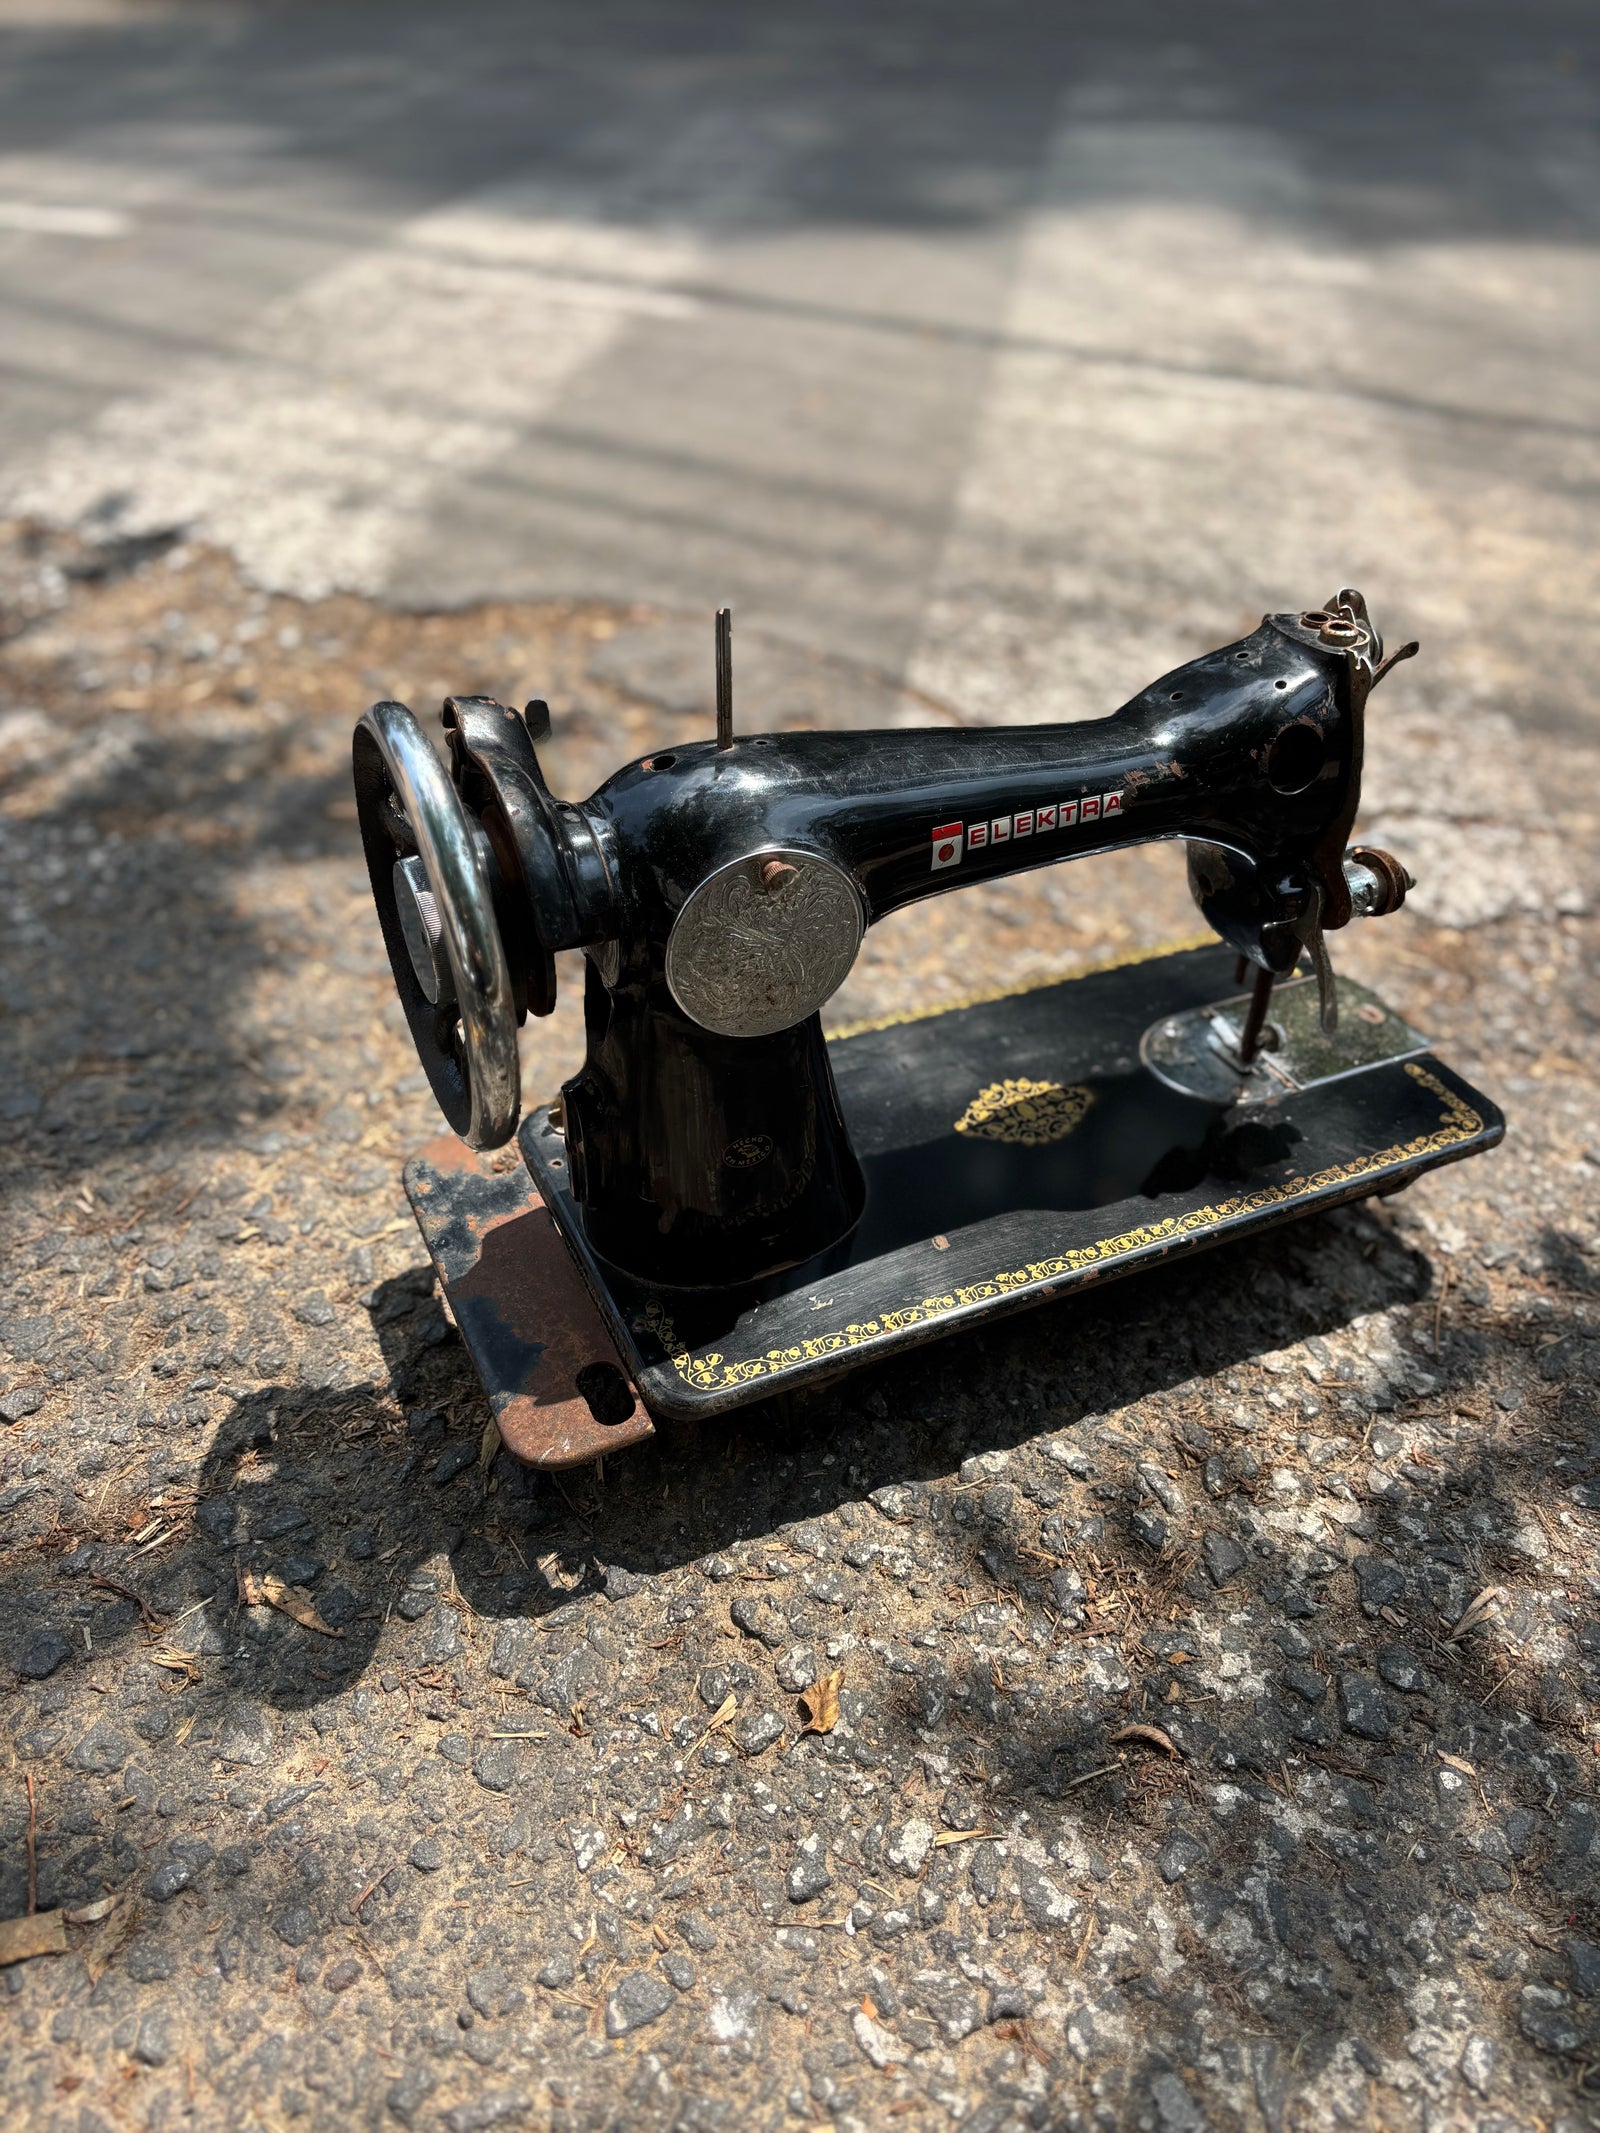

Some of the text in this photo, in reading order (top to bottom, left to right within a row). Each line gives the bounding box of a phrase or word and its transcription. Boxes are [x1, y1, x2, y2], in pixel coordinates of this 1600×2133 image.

[969, 794, 1122, 847] ELEKTRA
[732, 1136, 763, 1149] HECHO
[738, 1145, 770, 1165] MEXICO
